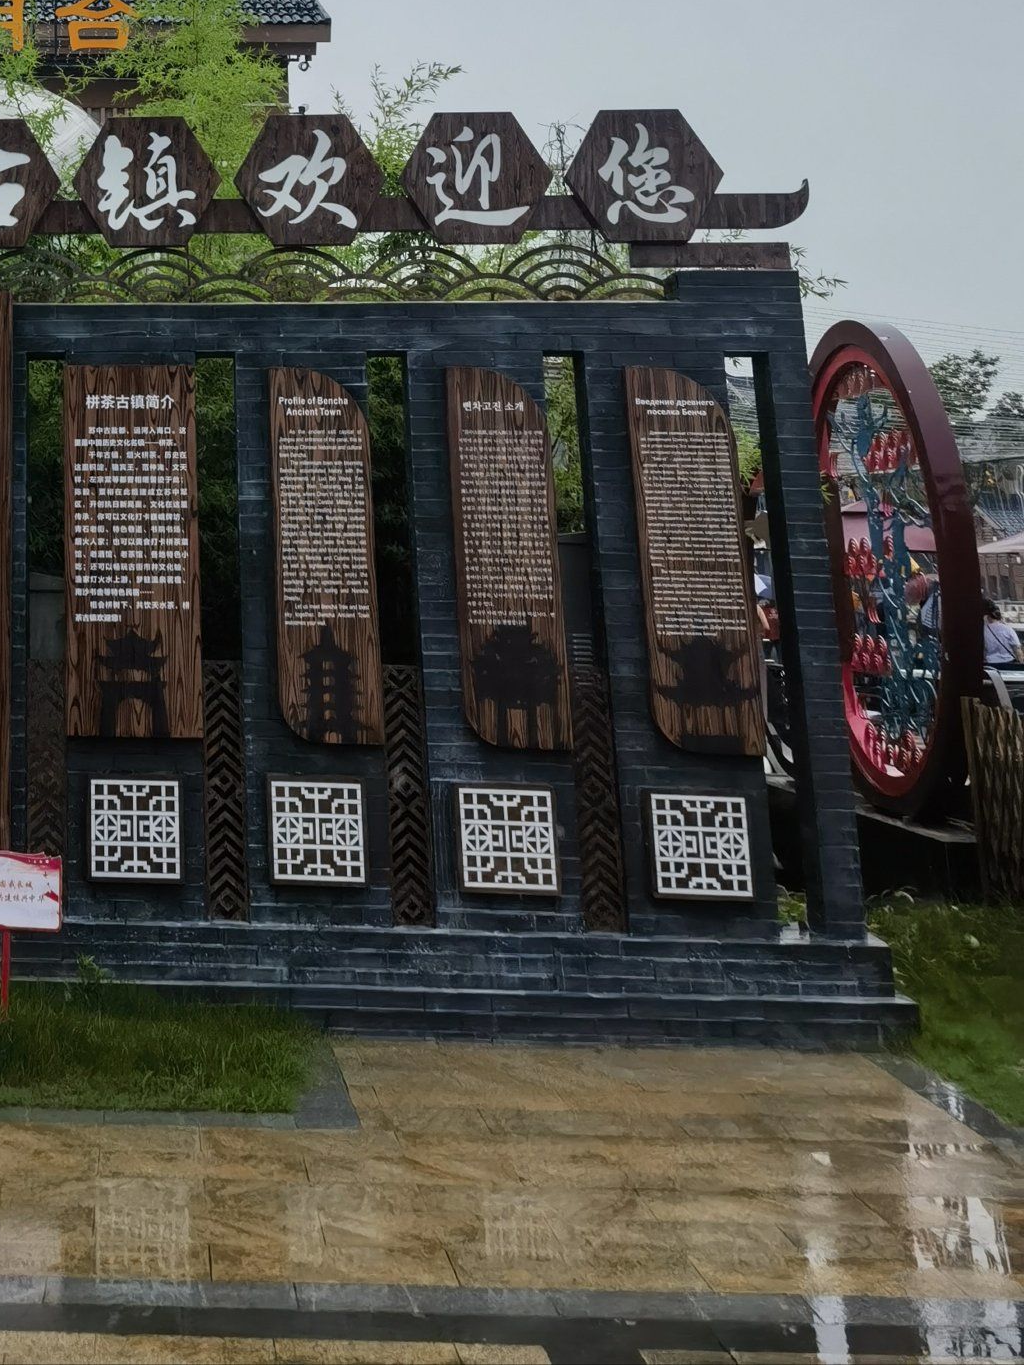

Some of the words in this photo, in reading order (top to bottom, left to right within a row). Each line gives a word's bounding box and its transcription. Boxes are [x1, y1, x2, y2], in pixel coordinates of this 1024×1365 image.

[85, 394, 174, 410] 栟茶古镇简介
[278, 396, 305, 405] Profile
[307, 396, 316, 405] of
[317, 396, 348, 405] Bencha
[635, 398, 674, 407] Введение
[676, 399, 714, 407] древнего
[504, 401, 524, 412] 소개
[286, 408, 318, 416] Ancient
[319, 408, 342, 416] Town
[682, 408, 707, 416] Бенча
